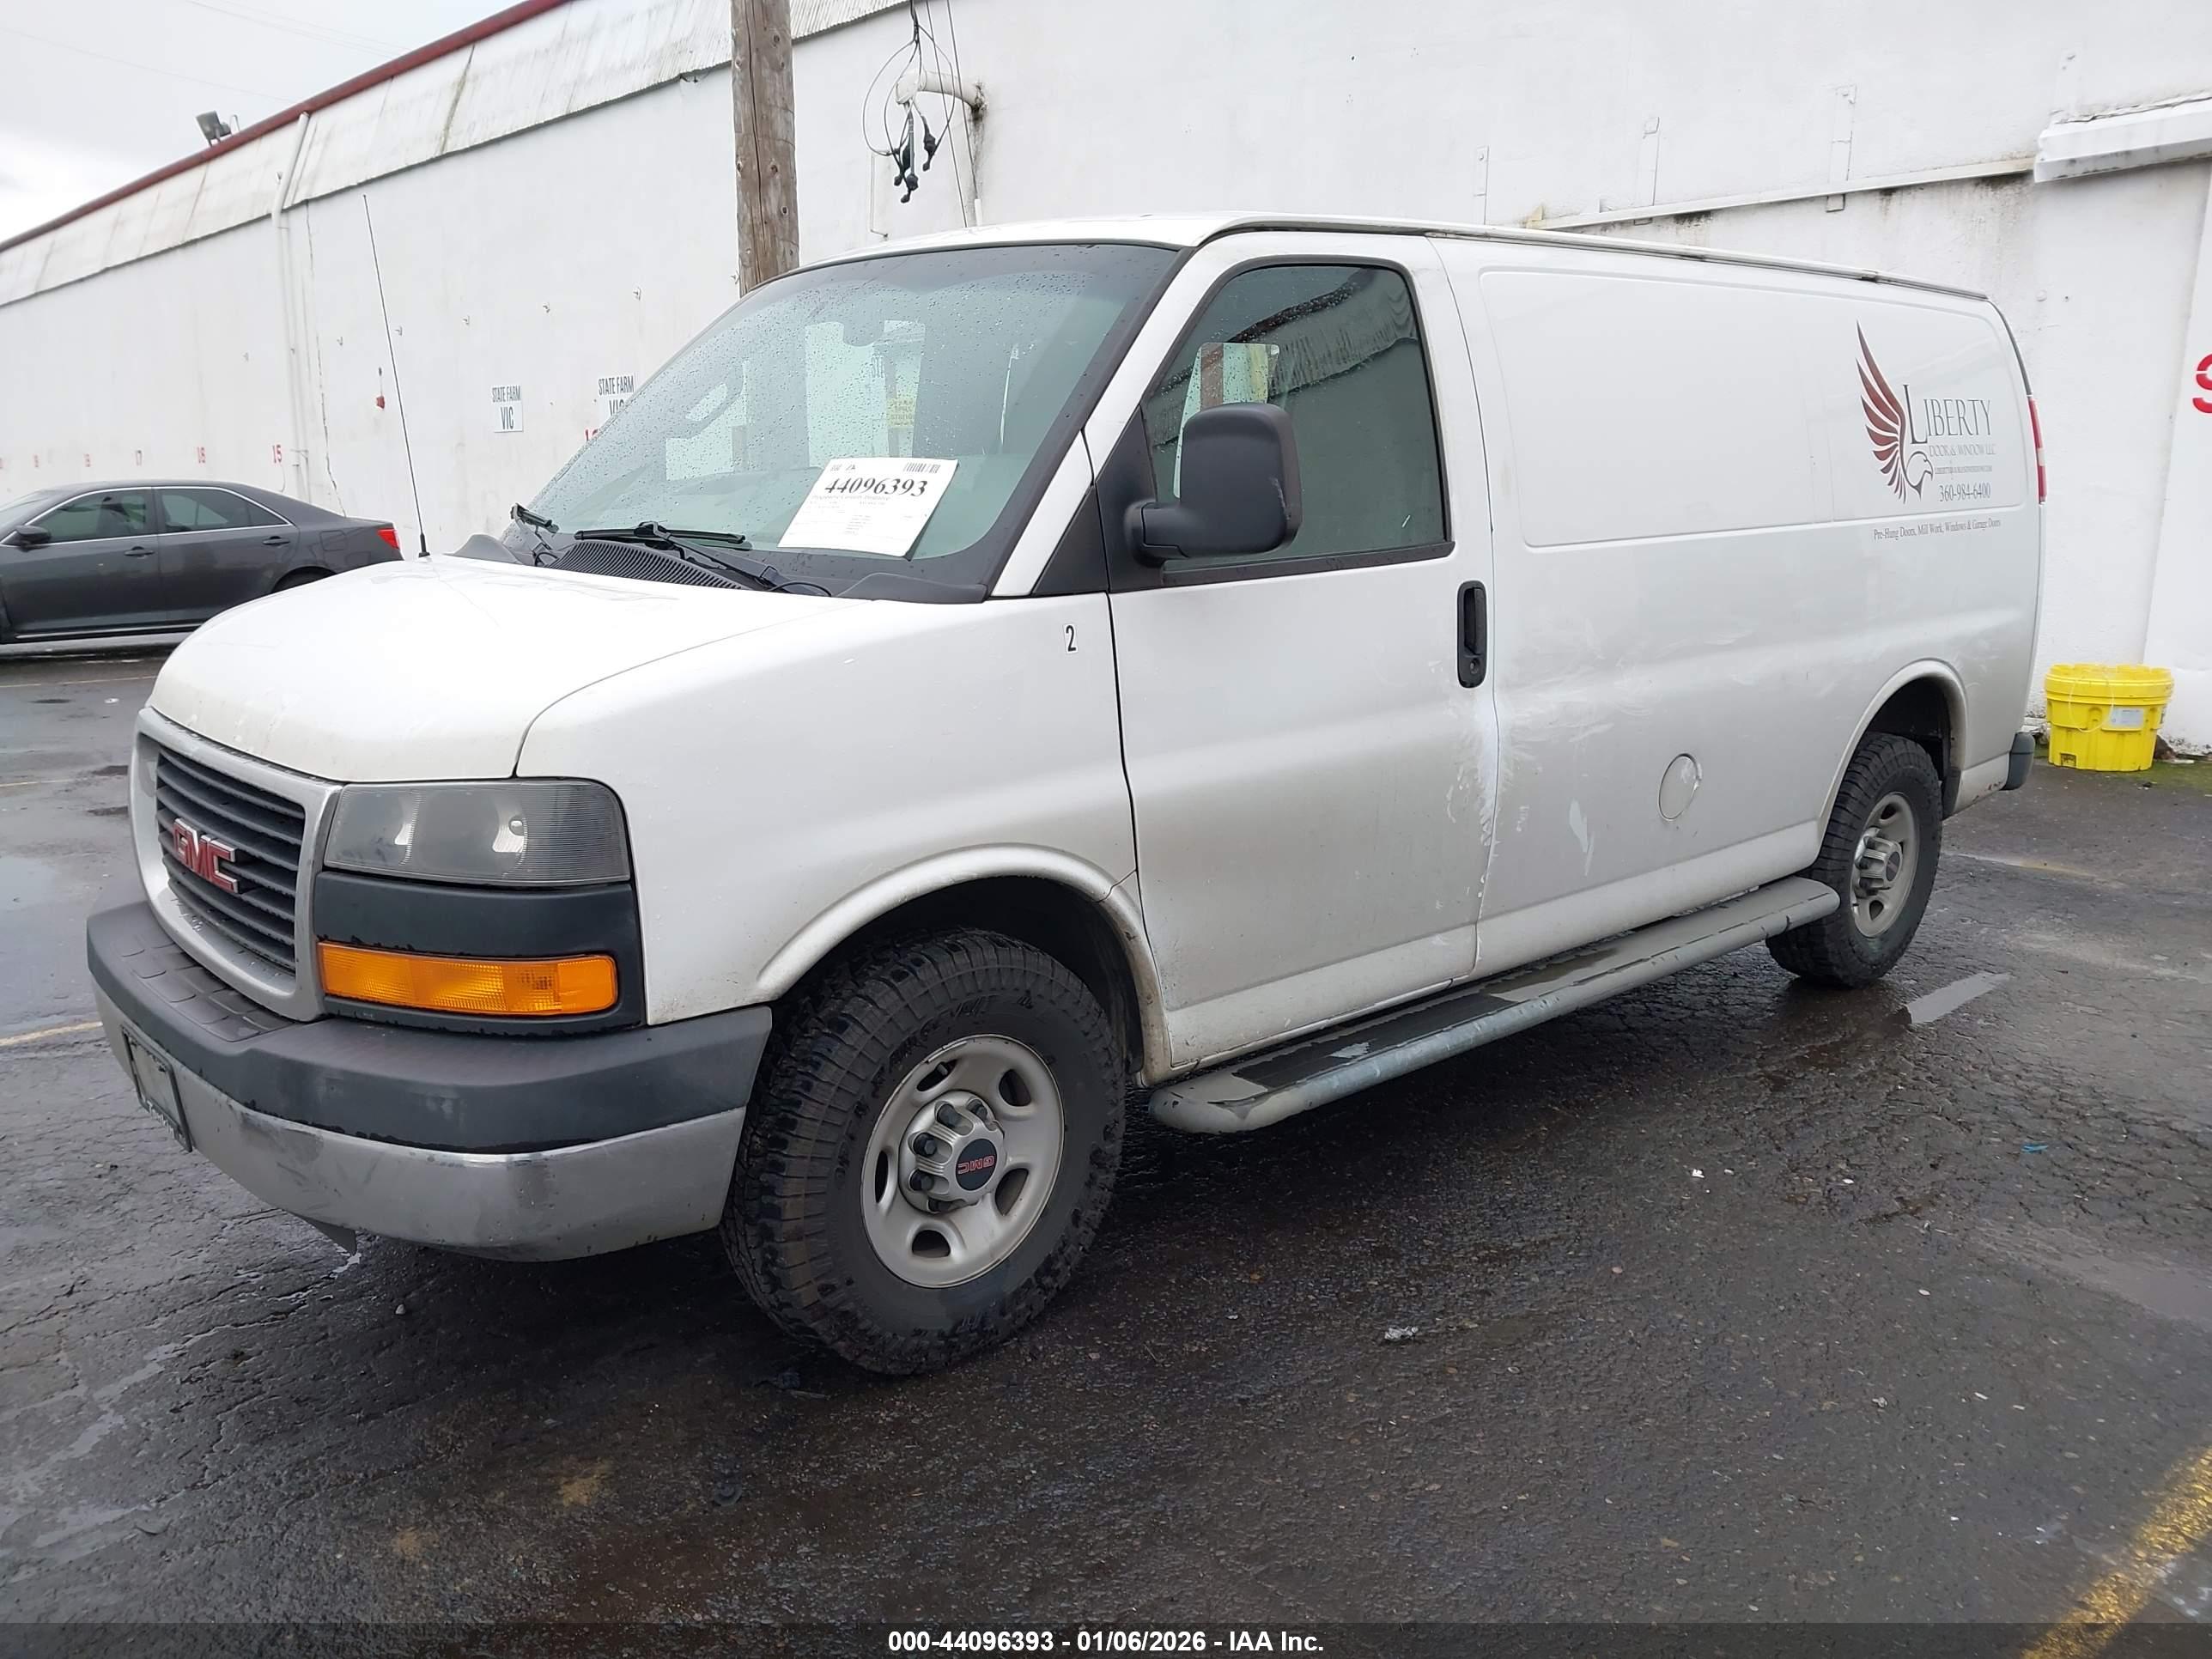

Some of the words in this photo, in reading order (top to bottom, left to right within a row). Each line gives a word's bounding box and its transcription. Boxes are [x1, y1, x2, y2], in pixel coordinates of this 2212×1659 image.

[492, 386, 506, 403] STATE
[507, 385, 521, 402] FARM
[598, 377, 616, 396] STATE
[617, 375, 634, 394] FARM
[500, 406, 514, 430] VIC
[271, 444, 283, 464] 15
[824, 477, 928, 497] 44096393
[1939, 482, 1991, 502] 360-984-6400
[1066, 624, 1077, 653] 2
[173, 817, 239, 894] GMC
[957, 1155, 995, 1175] GMC
